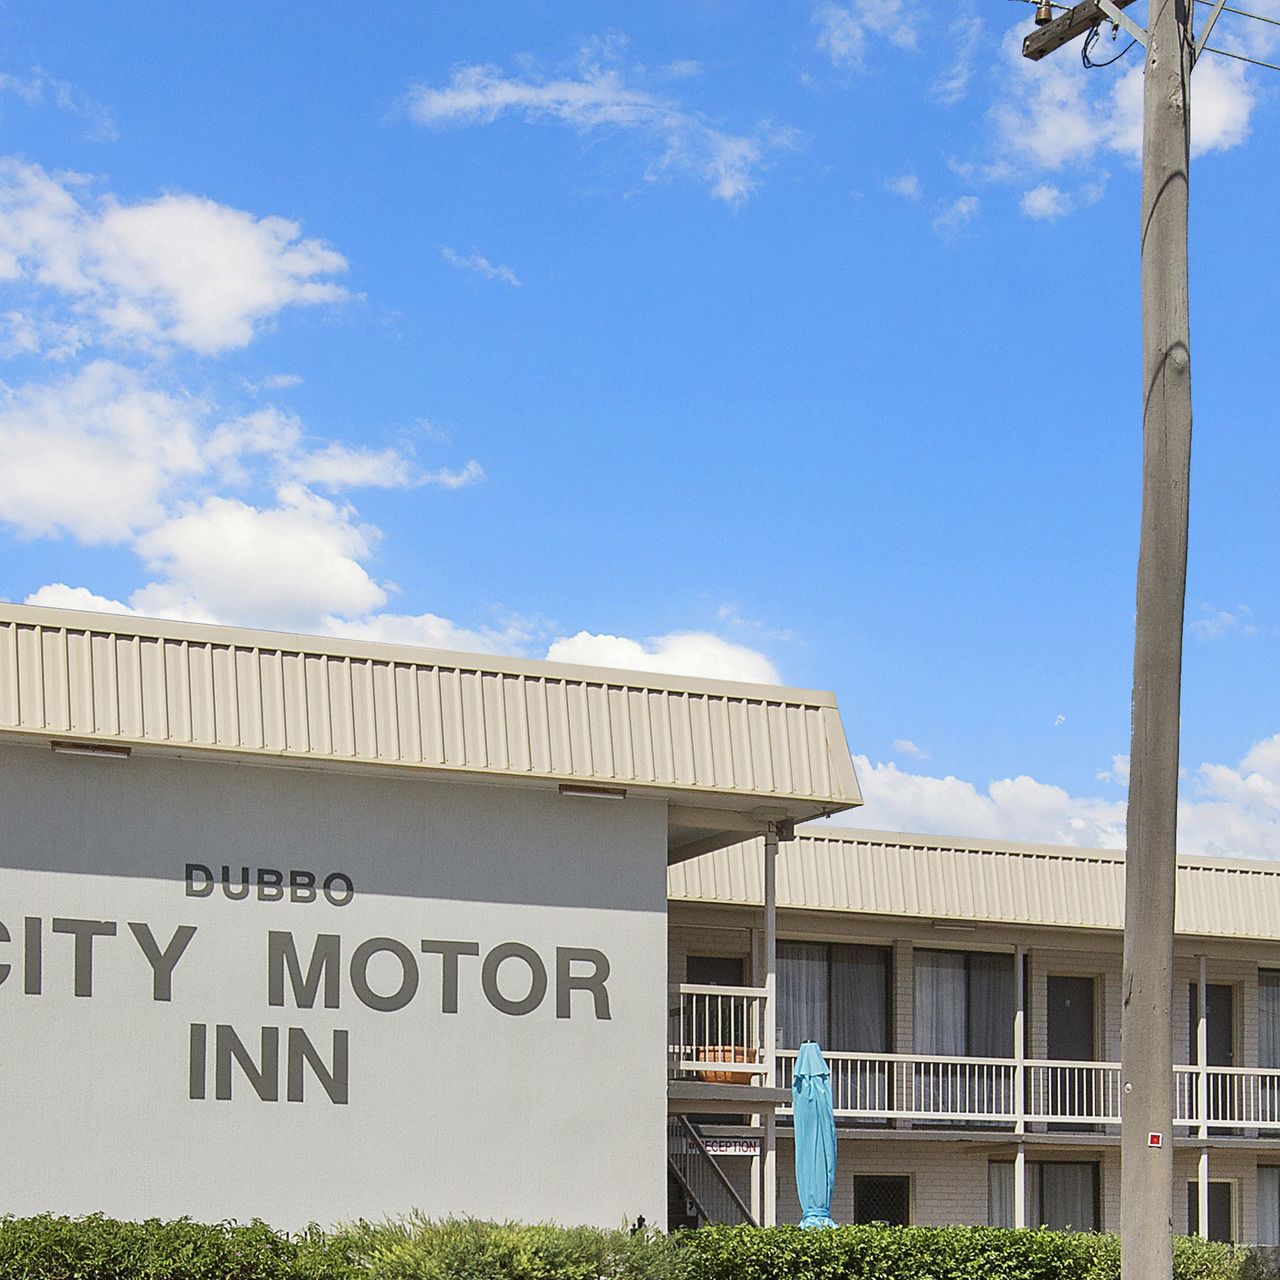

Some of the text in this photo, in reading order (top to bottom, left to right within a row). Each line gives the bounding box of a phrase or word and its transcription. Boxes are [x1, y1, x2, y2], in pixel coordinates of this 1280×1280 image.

[184, 864, 354, 906] DUBBO
[268, 930, 612, 1020] MOTOR
[189, 1023, 349, 1104] INN
[701, 1140, 757, 1152] ECEPTION
